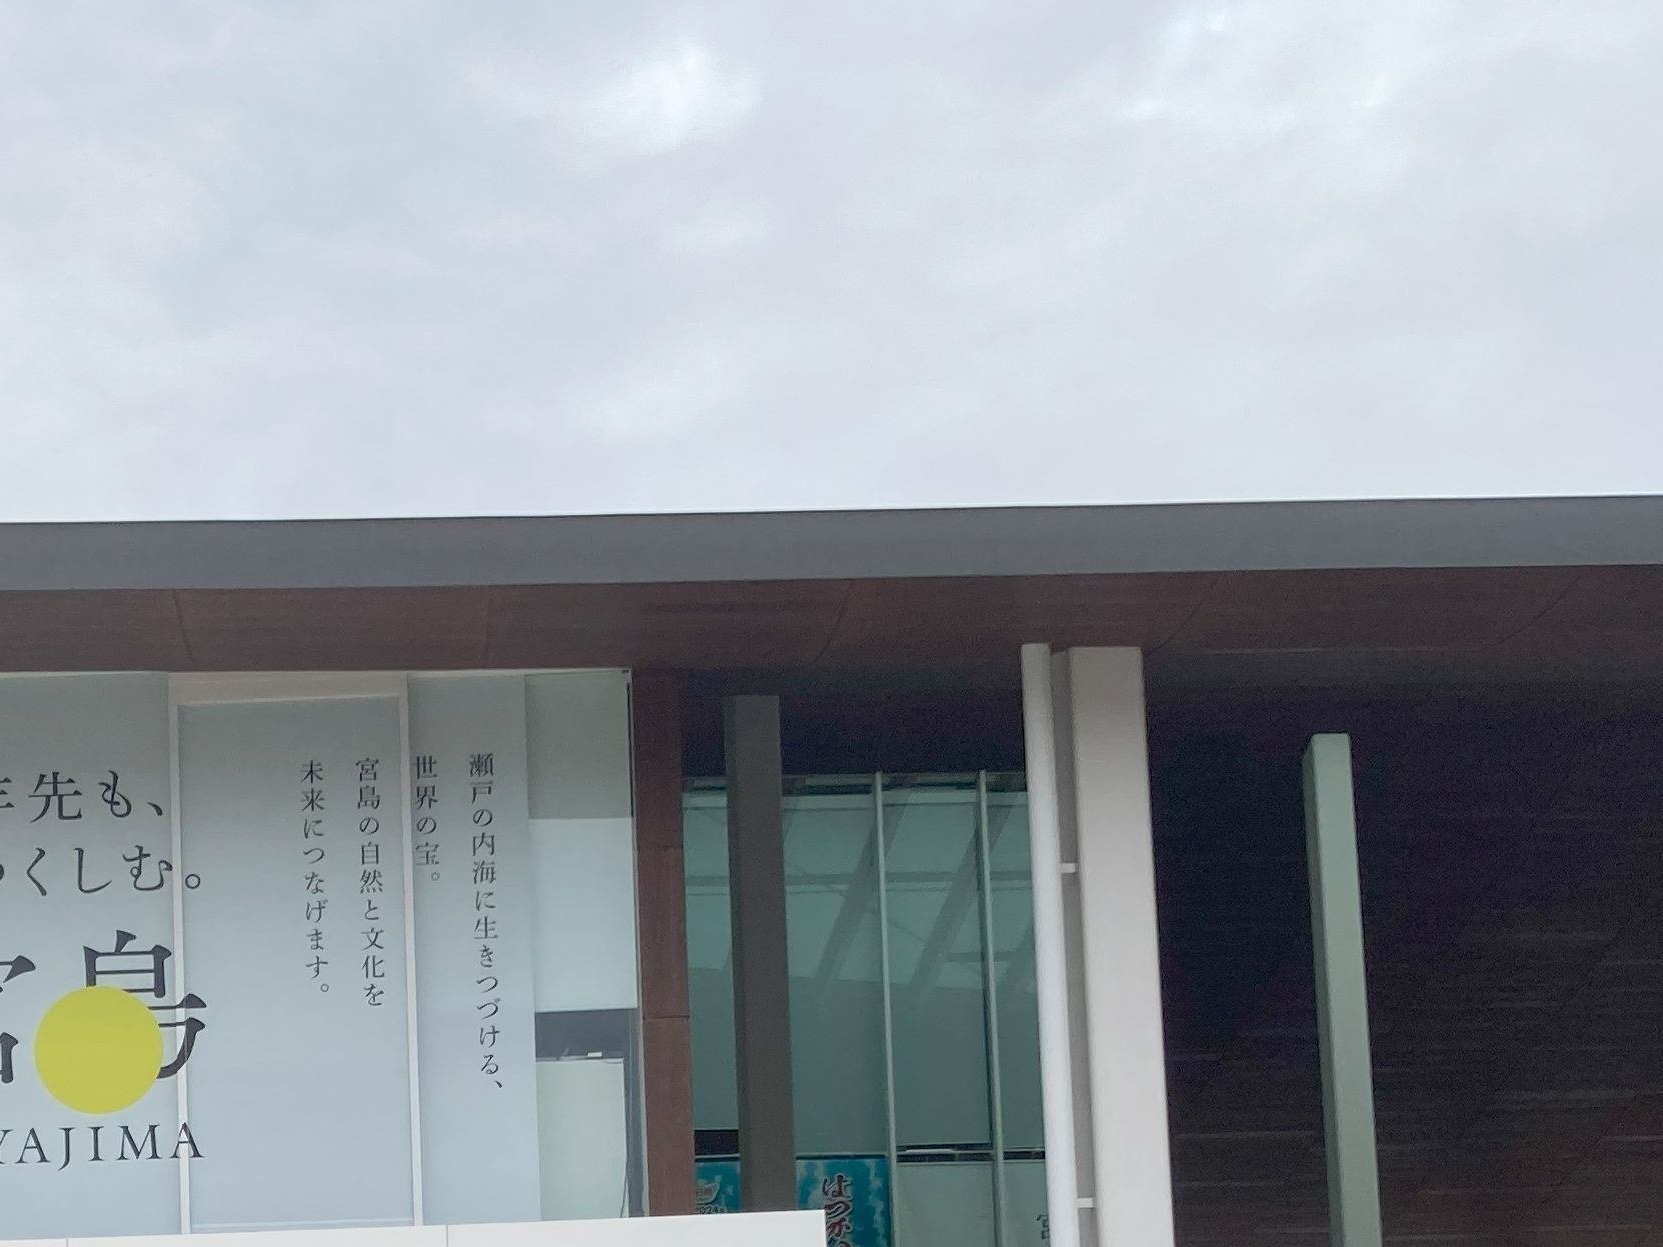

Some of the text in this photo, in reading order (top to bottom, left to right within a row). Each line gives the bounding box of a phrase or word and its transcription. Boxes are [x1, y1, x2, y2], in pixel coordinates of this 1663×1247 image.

[300, 760, 329, 994] 未来につなげます。
[355, 757, 386, 1008] 宮島の自然と文化を
[414, 754, 442, 882] 世界の宝。
[469, 752, 504, 1090] 瀬戸の内海に生きつづける、
